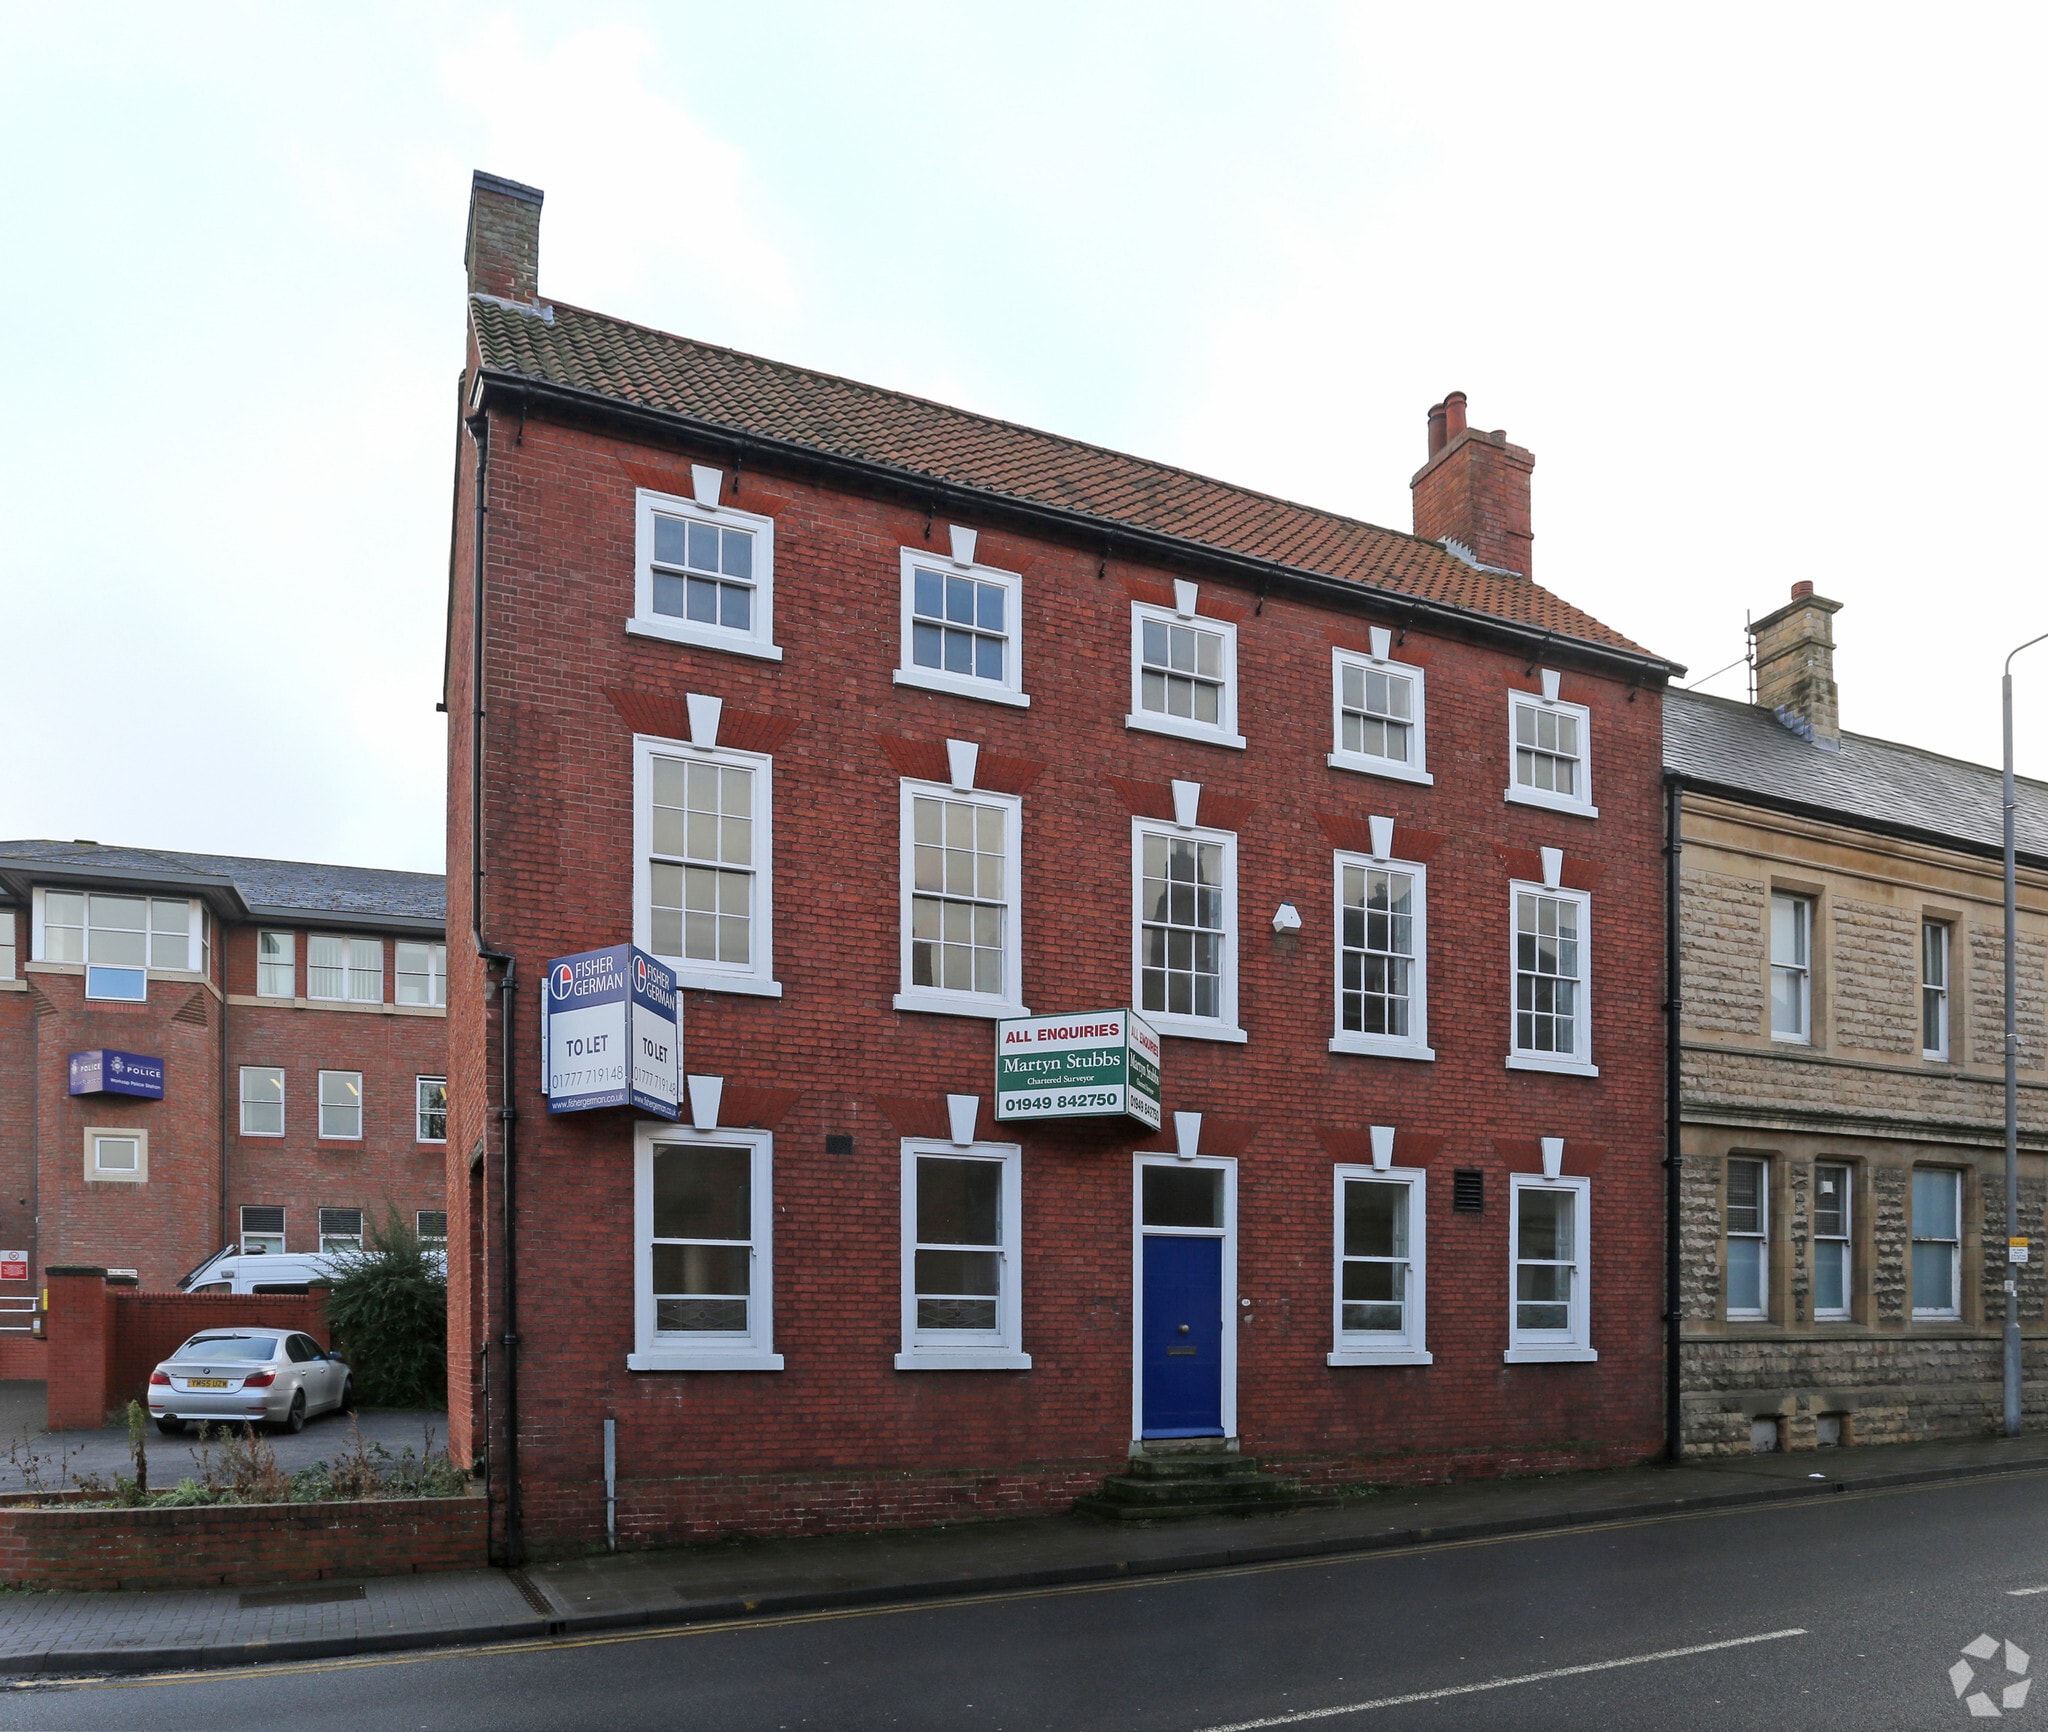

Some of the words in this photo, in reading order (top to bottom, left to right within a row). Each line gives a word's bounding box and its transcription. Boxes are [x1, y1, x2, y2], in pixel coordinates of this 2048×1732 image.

[575, 956, 613, 979] FISHER
[647, 964, 669, 991] FISHER
[574, 973, 623, 996] GERMAN
[646, 982, 676, 1011] GERMAN
[1005, 1031, 1032, 1044] ALL
[1037, 1023, 1120, 1041] ENQUIRIES
[1131, 1025, 1139, 1041] ALL
[1139, 1032, 1159, 1057] ENQUIRIES
[566, 1039, 584, 1057] TO
[586, 1034, 608, 1053] LET
[642, 1037, 654, 1057] TO
[655, 1045, 668, 1064] LET
[80, 1063, 101, 1072] POLICE
[127, 1066, 161, 1078] POLICE
[1003, 1055, 1061, 1074] Martyn
[1066, 1050, 1121, 1069] Stubbs
[130, 1080, 145, 1088] Police
[145, 1082, 161, 1090] Station
[552, 1071, 583, 1089] 01777
[586, 1065, 624, 1084] 719148
[634, 1066, 654, 1086] 01777
[654, 1072, 676, 1097] 719148
[1027, 1075, 1062, 1086] Chartered
[1063, 1074, 1095, 1084] Surveyor
[552, 1092, 624, 1109] www.fishergerman.co.uk
[1005, 1096, 1055, 1111] 01949
[1057, 1093, 1118, 1108] 842750
[1130, 1094, 1144, 1113] 01949
[1144, 1103, 1159, 1121] 842750
